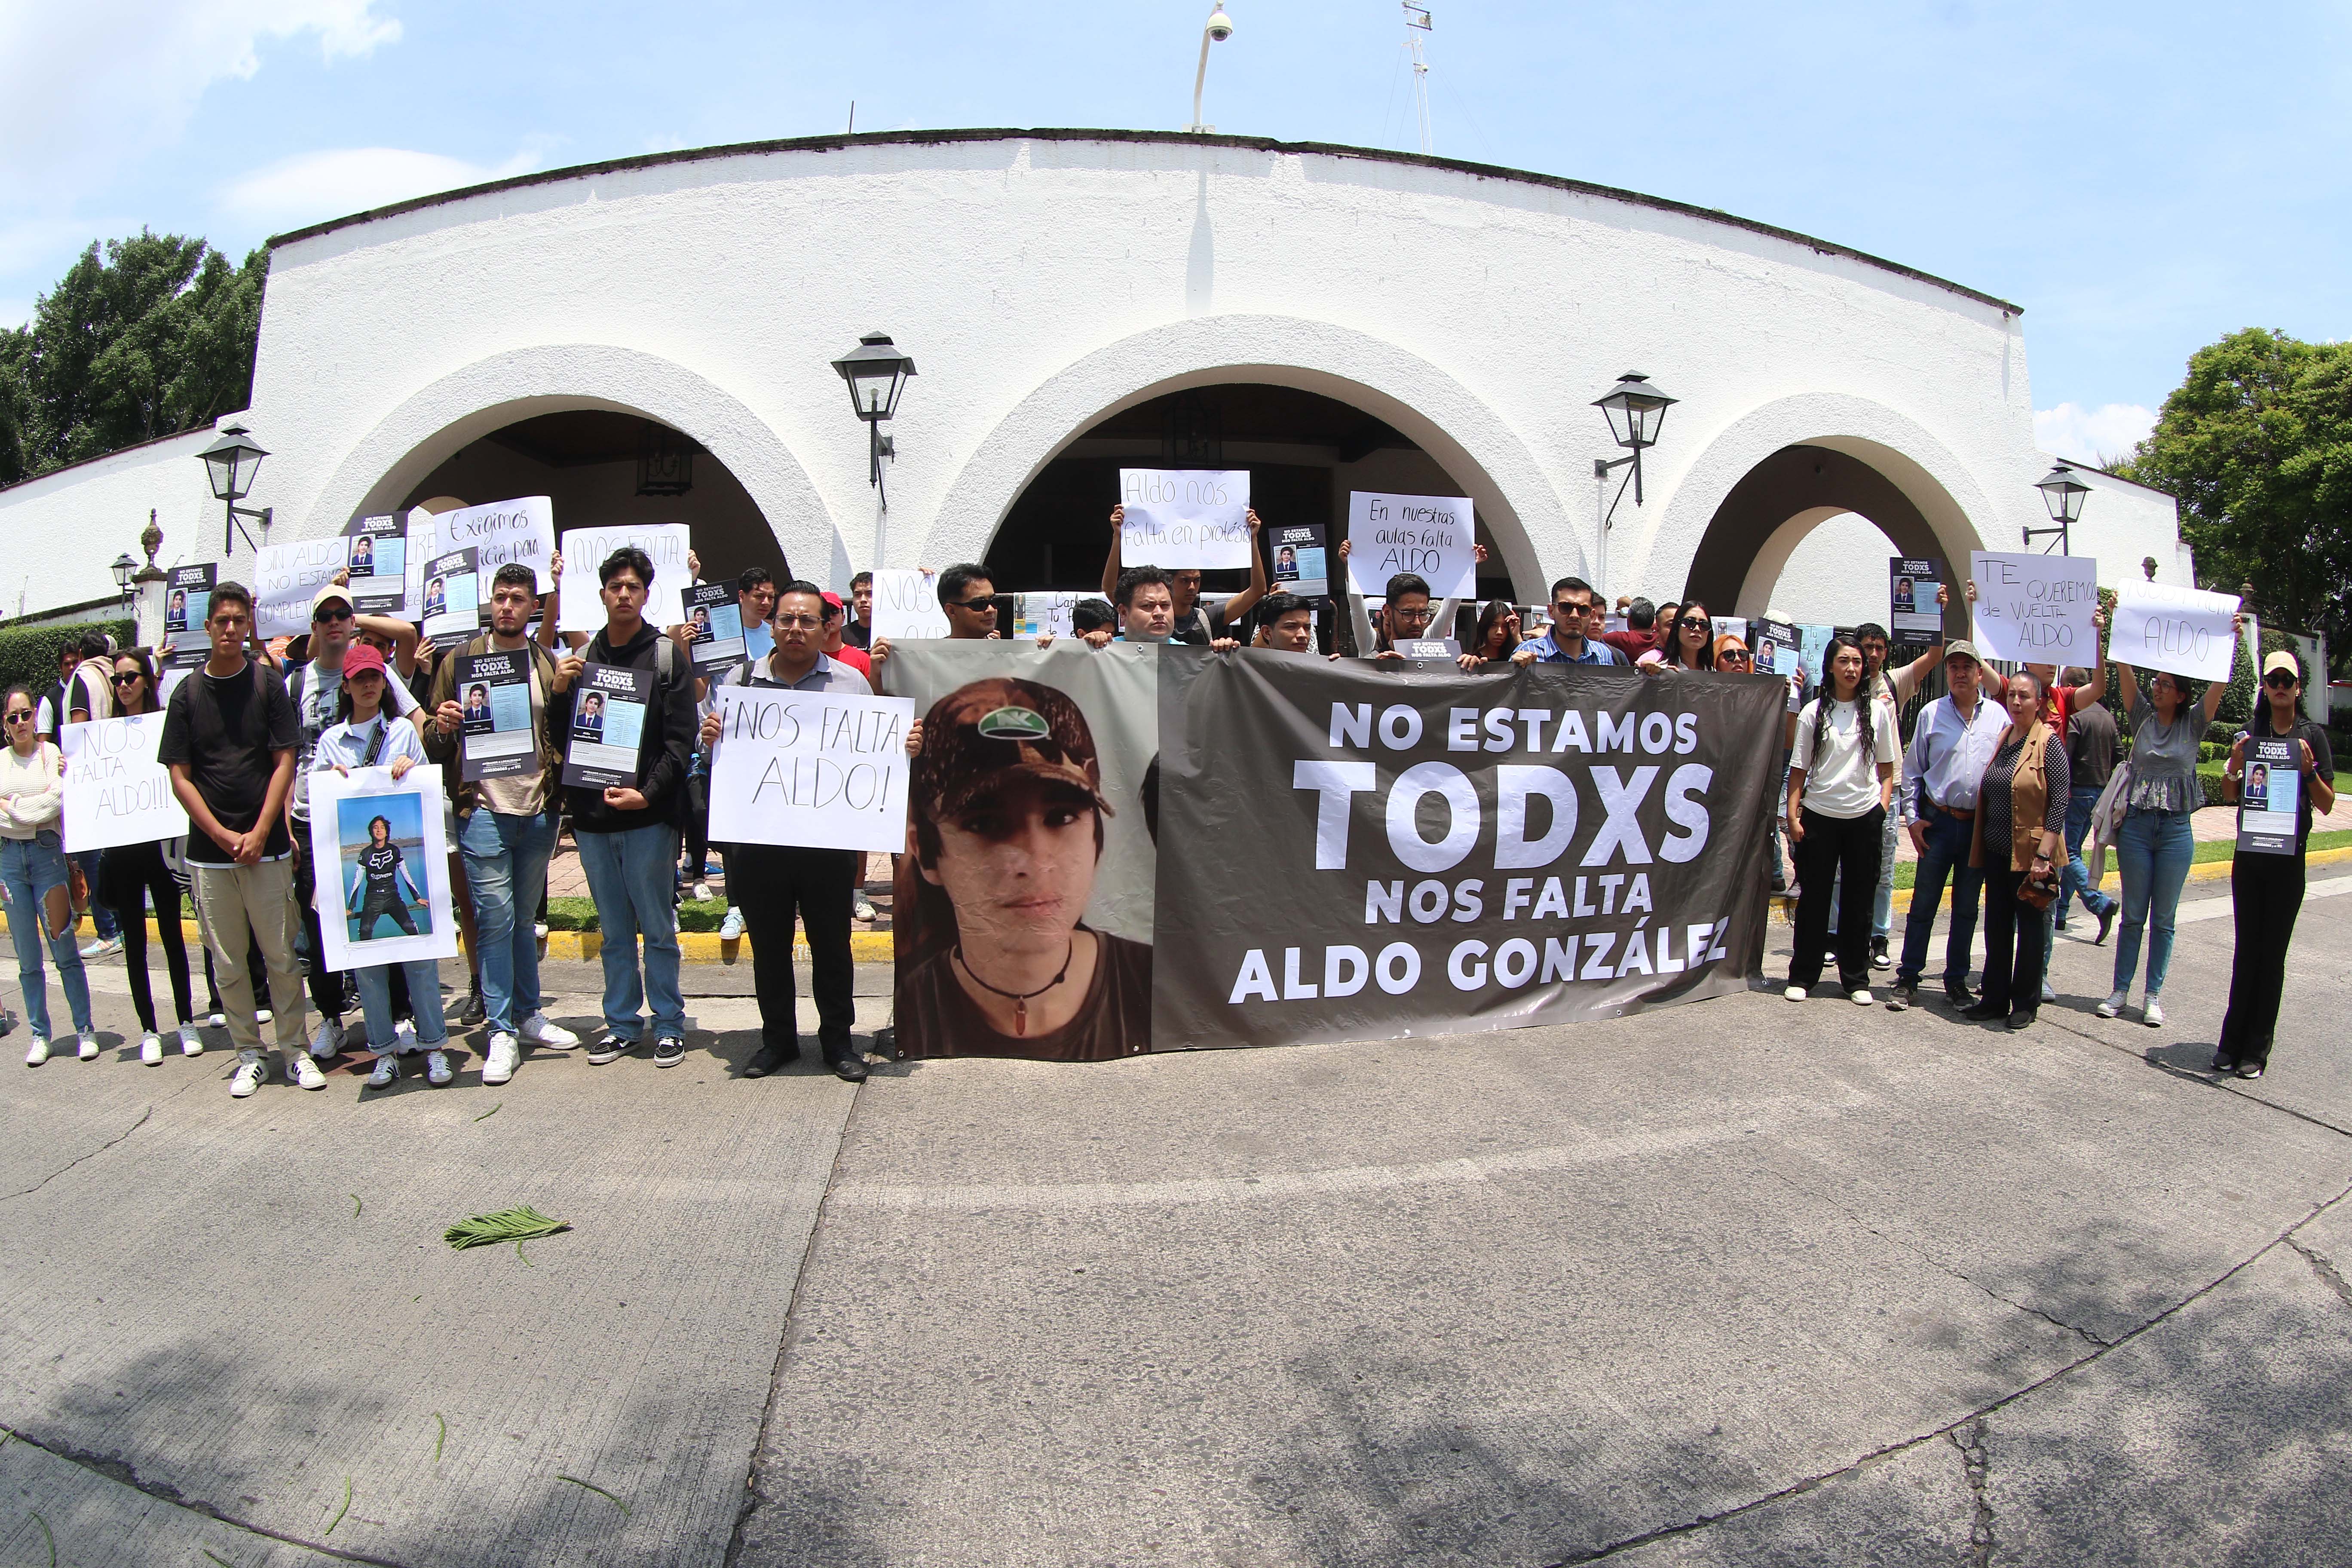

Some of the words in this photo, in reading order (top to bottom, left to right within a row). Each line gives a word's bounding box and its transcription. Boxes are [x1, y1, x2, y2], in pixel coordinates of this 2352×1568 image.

[1126, 473, 1175, 503] Aldo
[1186, 481, 1227, 505] nos
[364, 519, 393, 528] TODXS
[1370, 499, 1388, 521] En
[1403, 506, 1455, 525] nuestras
[450, 510, 528, 545] Exigimos
[1172, 525, 1192, 545] en
[1283, 531, 1311, 539] TODXS
[1376, 527, 1415, 545] aulas
[261, 549, 284, 572] SIN
[293, 542, 342, 567] ALDO
[435, 556, 464, 570] TODXS
[514, 538, 539, 563] para
[1380, 548, 1440, 574] ALDO
[178, 571, 204, 581] TODXS
[269, 576, 290, 591] NO
[1978, 560, 2020, 584] TE
[695, 588, 724, 599] TODXS
[879, 575, 933, 613] NOS
[2027, 580, 2096, 603] QUEREMOS
[1047, 608, 1059, 622] Tu
[1981, 596, 2000, 617] de
[2011, 602, 2067, 620] VUELTA
[1769, 626, 1791, 638] TODXS
[1806, 625, 1817, 638] Tu
[2018, 622, 2073, 648] ALDO
[2144, 616, 2209, 662] ALDO
[473, 660, 511, 673] TODXS
[596, 673, 634, 686] TODXS
[84, 717, 145, 759] NOS
[720, 698, 800, 748] ¡NOS
[820, 707, 898, 754] FALTA
[1329, 702, 1423, 750] NO
[1447, 707, 1697, 754] ESTAMOS
[2258, 746, 2288, 755] TODXS
[73, 756, 126, 784] FALTA
[752, 756, 891, 813] ALDO!
[95, 775, 168, 820] ALDO!!!
[1292, 760, 1714, 873] TODXS
[1365, 879, 1484, 924] NOS
[1503, 873, 1653, 920] FALTA
[1228, 941, 1422, 1004] ALDO
[1447, 916, 1730, 991] GONZÁLEZ
